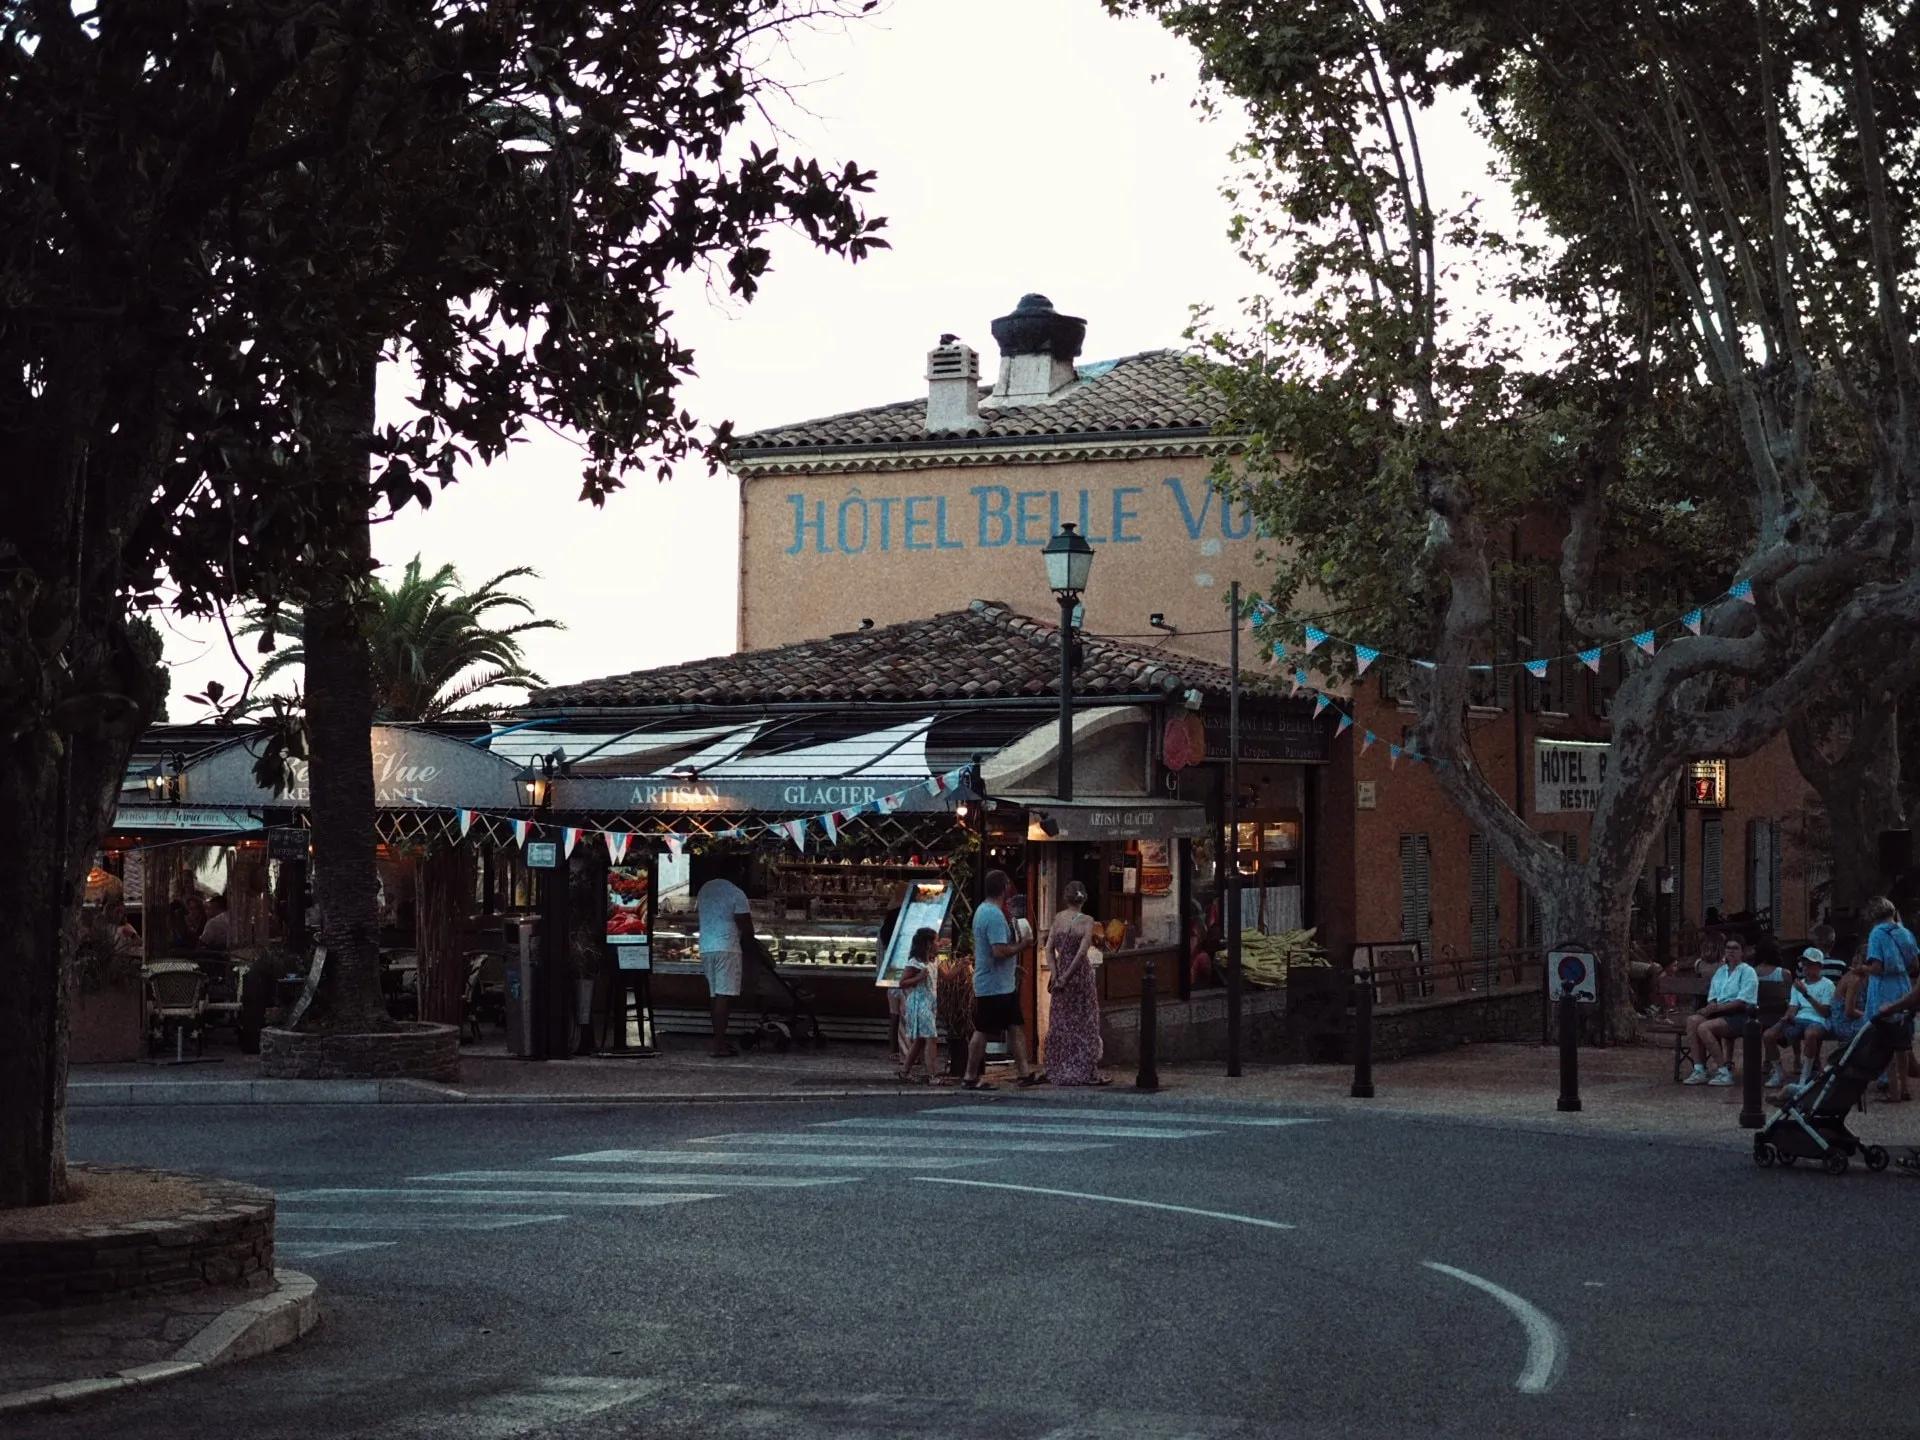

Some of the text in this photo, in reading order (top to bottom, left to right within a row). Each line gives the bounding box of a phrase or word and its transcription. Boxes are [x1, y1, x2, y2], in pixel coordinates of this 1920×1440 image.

[784, 476, 1272, 556] HÔTEL BELLE VU
[1205, 742, 1228, 756] laces
[374, 751, 442, 783] Vue
[1541, 746, 1587, 783] HÔTEL
[630, 785, 876, 805] ARTISAN GLACIER
[1089, 812, 1154, 826] ARTISAN GLACIER
